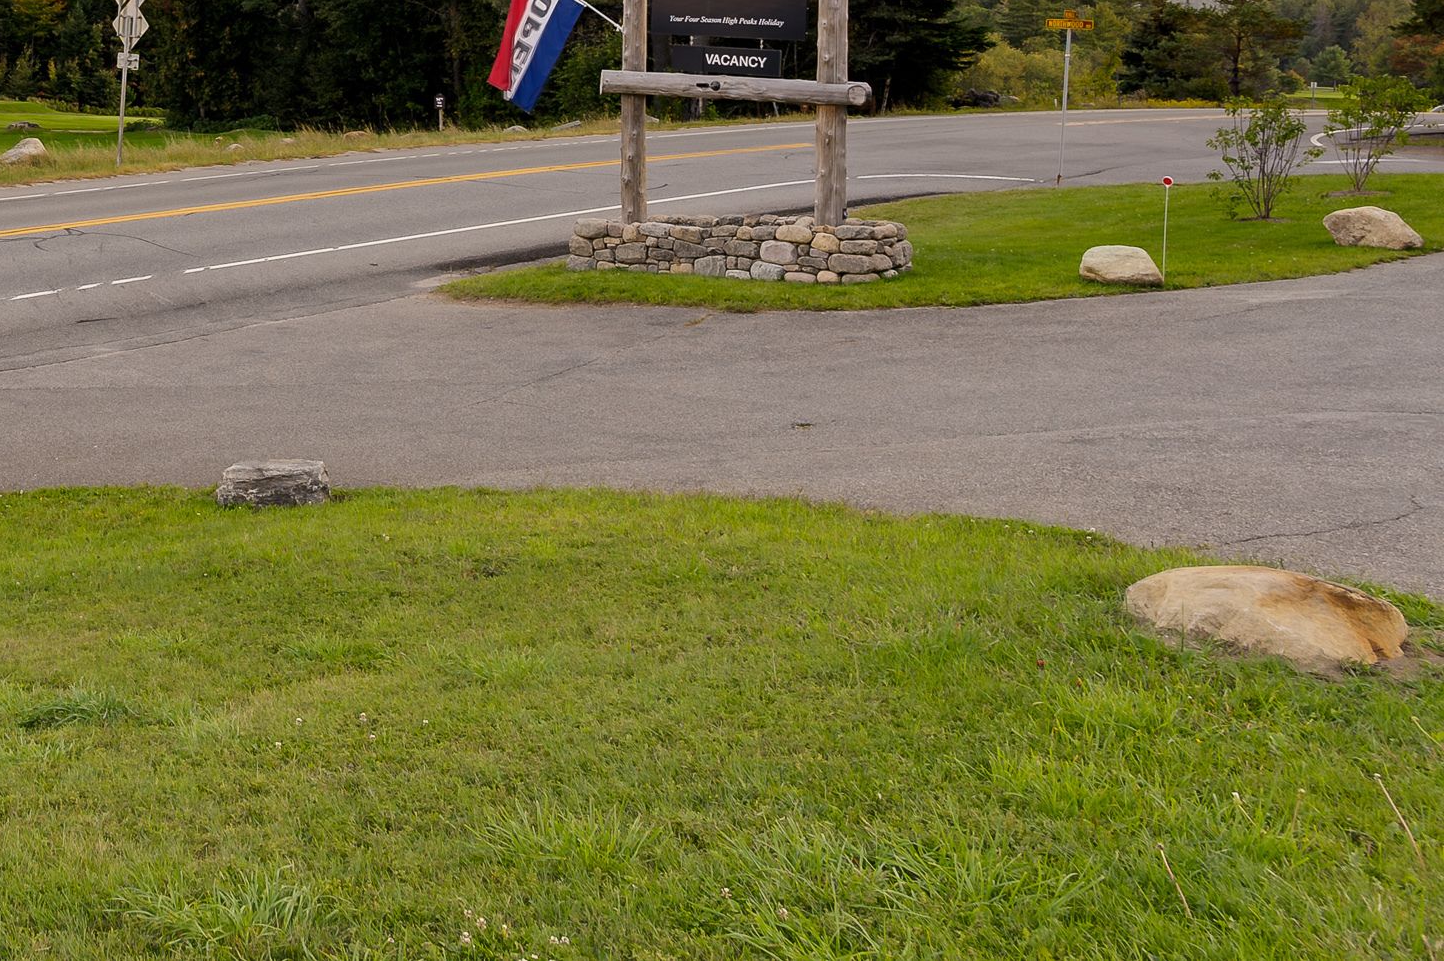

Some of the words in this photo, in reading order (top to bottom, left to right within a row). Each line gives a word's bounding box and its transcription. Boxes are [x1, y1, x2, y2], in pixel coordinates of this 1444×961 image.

[669, 15, 684, 23] Your
[684, 15, 700, 23] Four
[700, 15, 722, 24] Season
[722, 16, 738, 26] High
[738, 17, 757, 26] Peaks
[758, 18, 785, 28] Holiday
[705, 53, 767, 68] VACANCY
